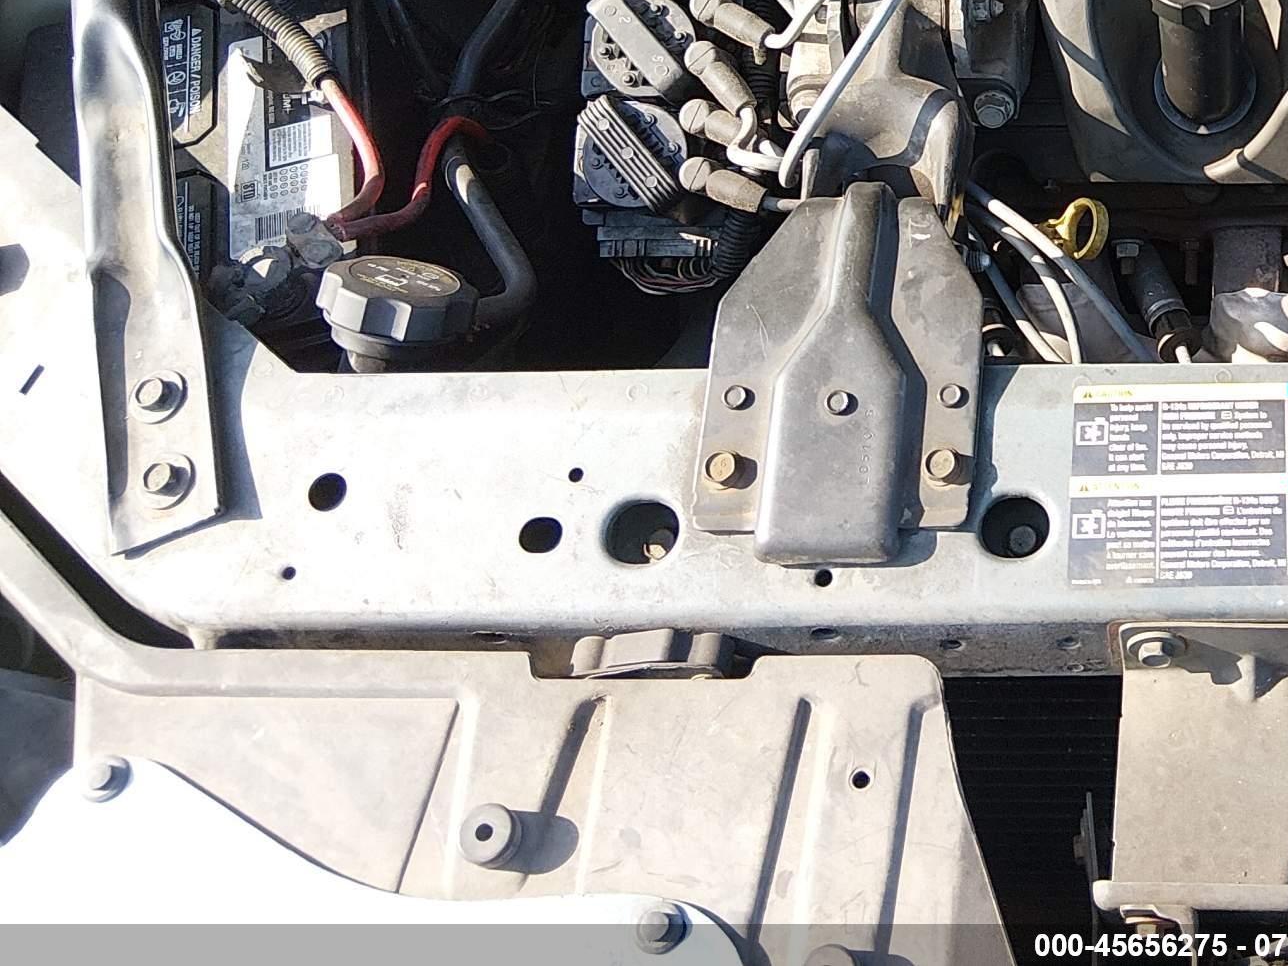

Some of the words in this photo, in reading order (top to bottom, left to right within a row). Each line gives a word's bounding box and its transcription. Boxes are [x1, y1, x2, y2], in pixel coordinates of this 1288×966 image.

[191, 36, 202, 72] DANGER
[189, 81, 201, 114] POISON
[243, 183, 255, 200] STD
